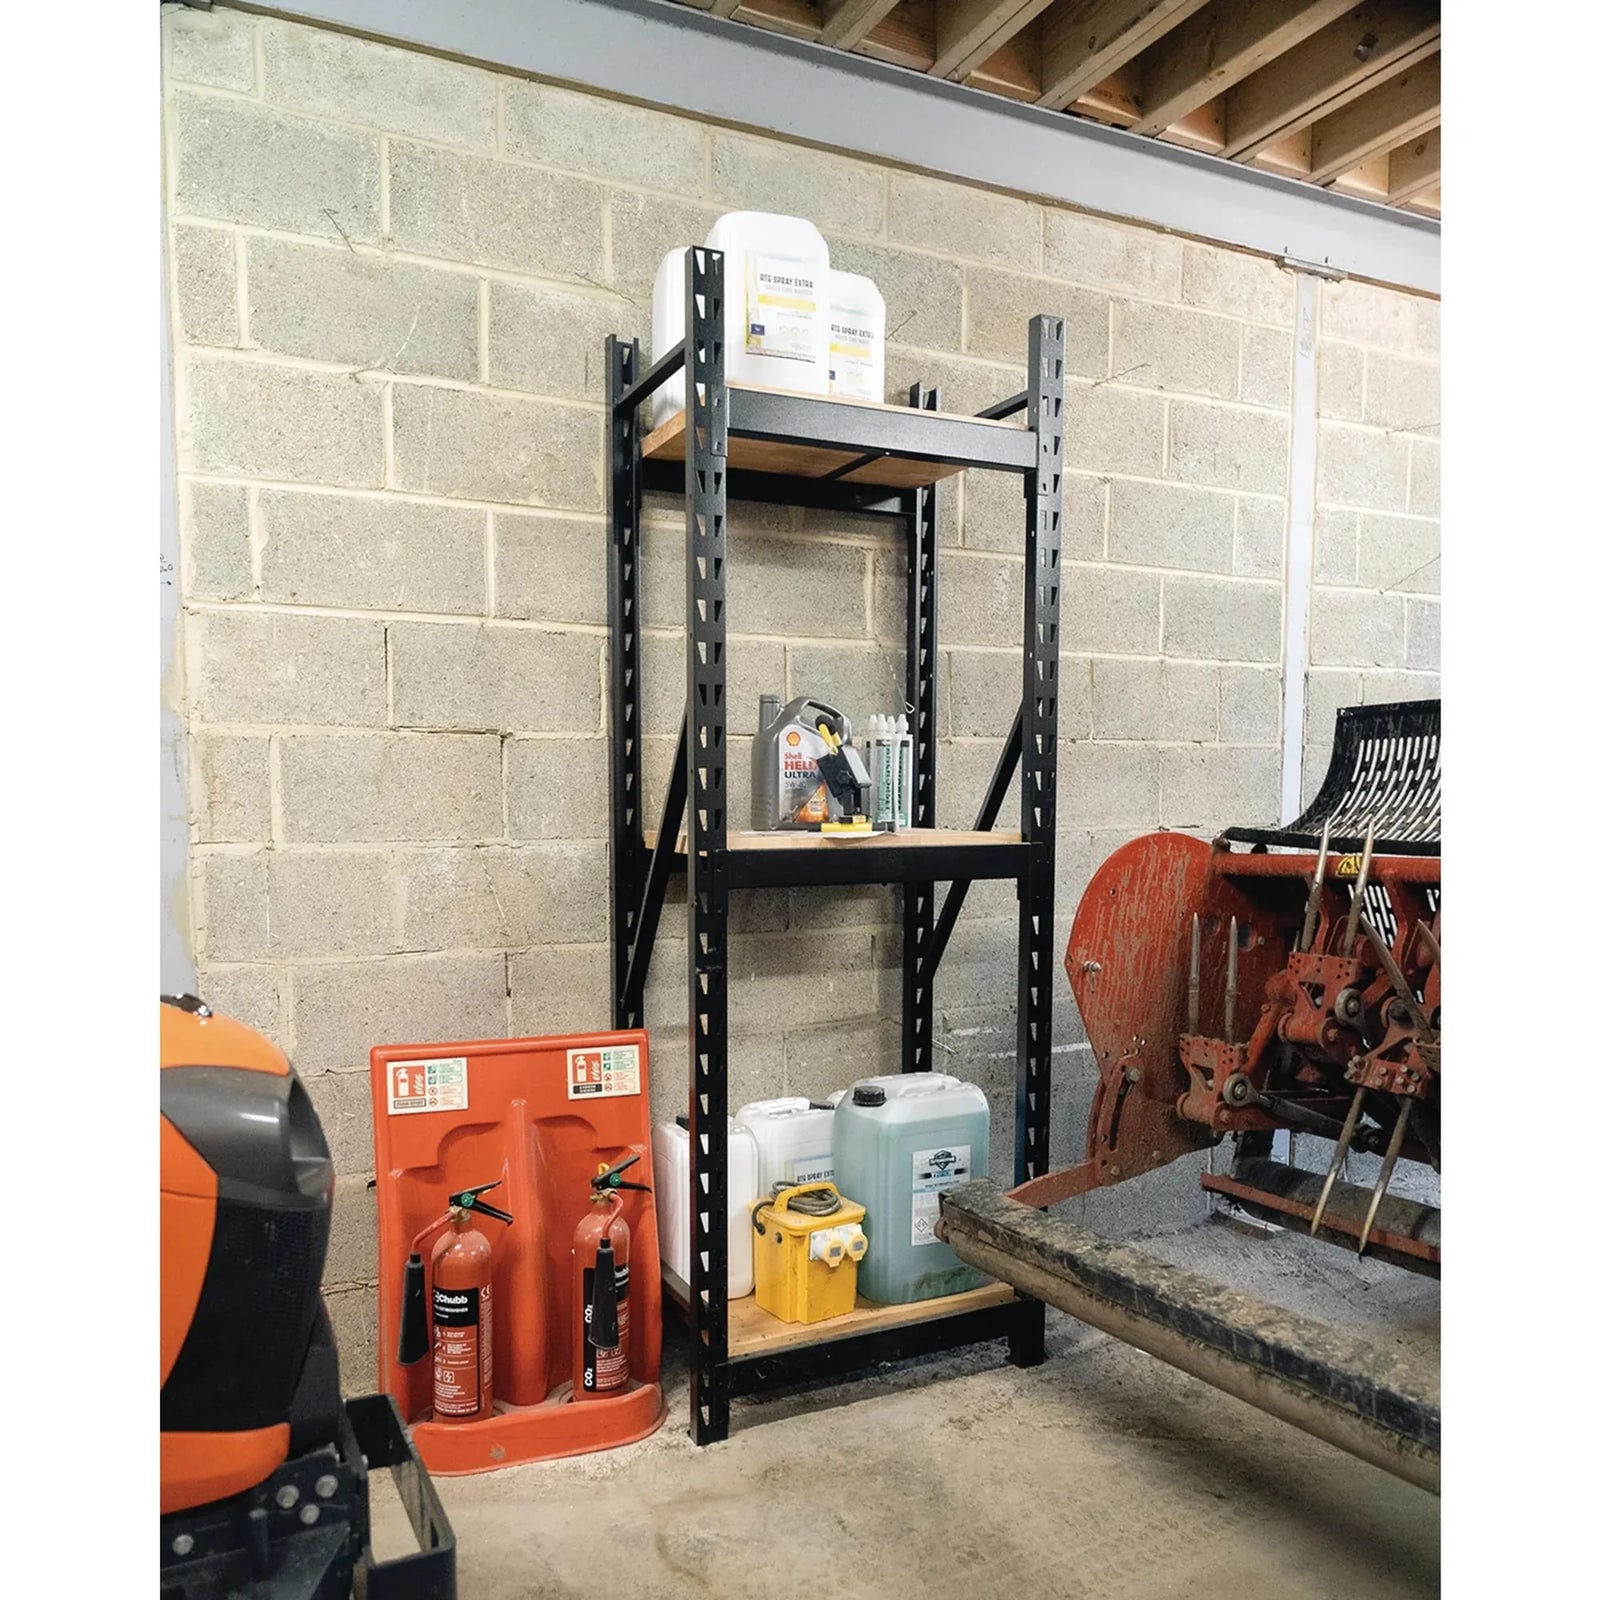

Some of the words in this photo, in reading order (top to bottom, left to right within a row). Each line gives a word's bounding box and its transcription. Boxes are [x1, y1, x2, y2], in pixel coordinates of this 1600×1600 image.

[760, 273, 771, 283] RTG
[773, 275, 792, 285] SPRAY
[794, 278, 813, 288] EXTRA
[842, 326, 857, 336] SPRAY
[784, 752, 802, 760] Shell
[784, 771, 817, 779] ULTRA
[807, 1171, 823, 1181] SPRAY
[439, 1294, 468, 1304] Chubb
[585, 1368, 593, 1387] CO2
